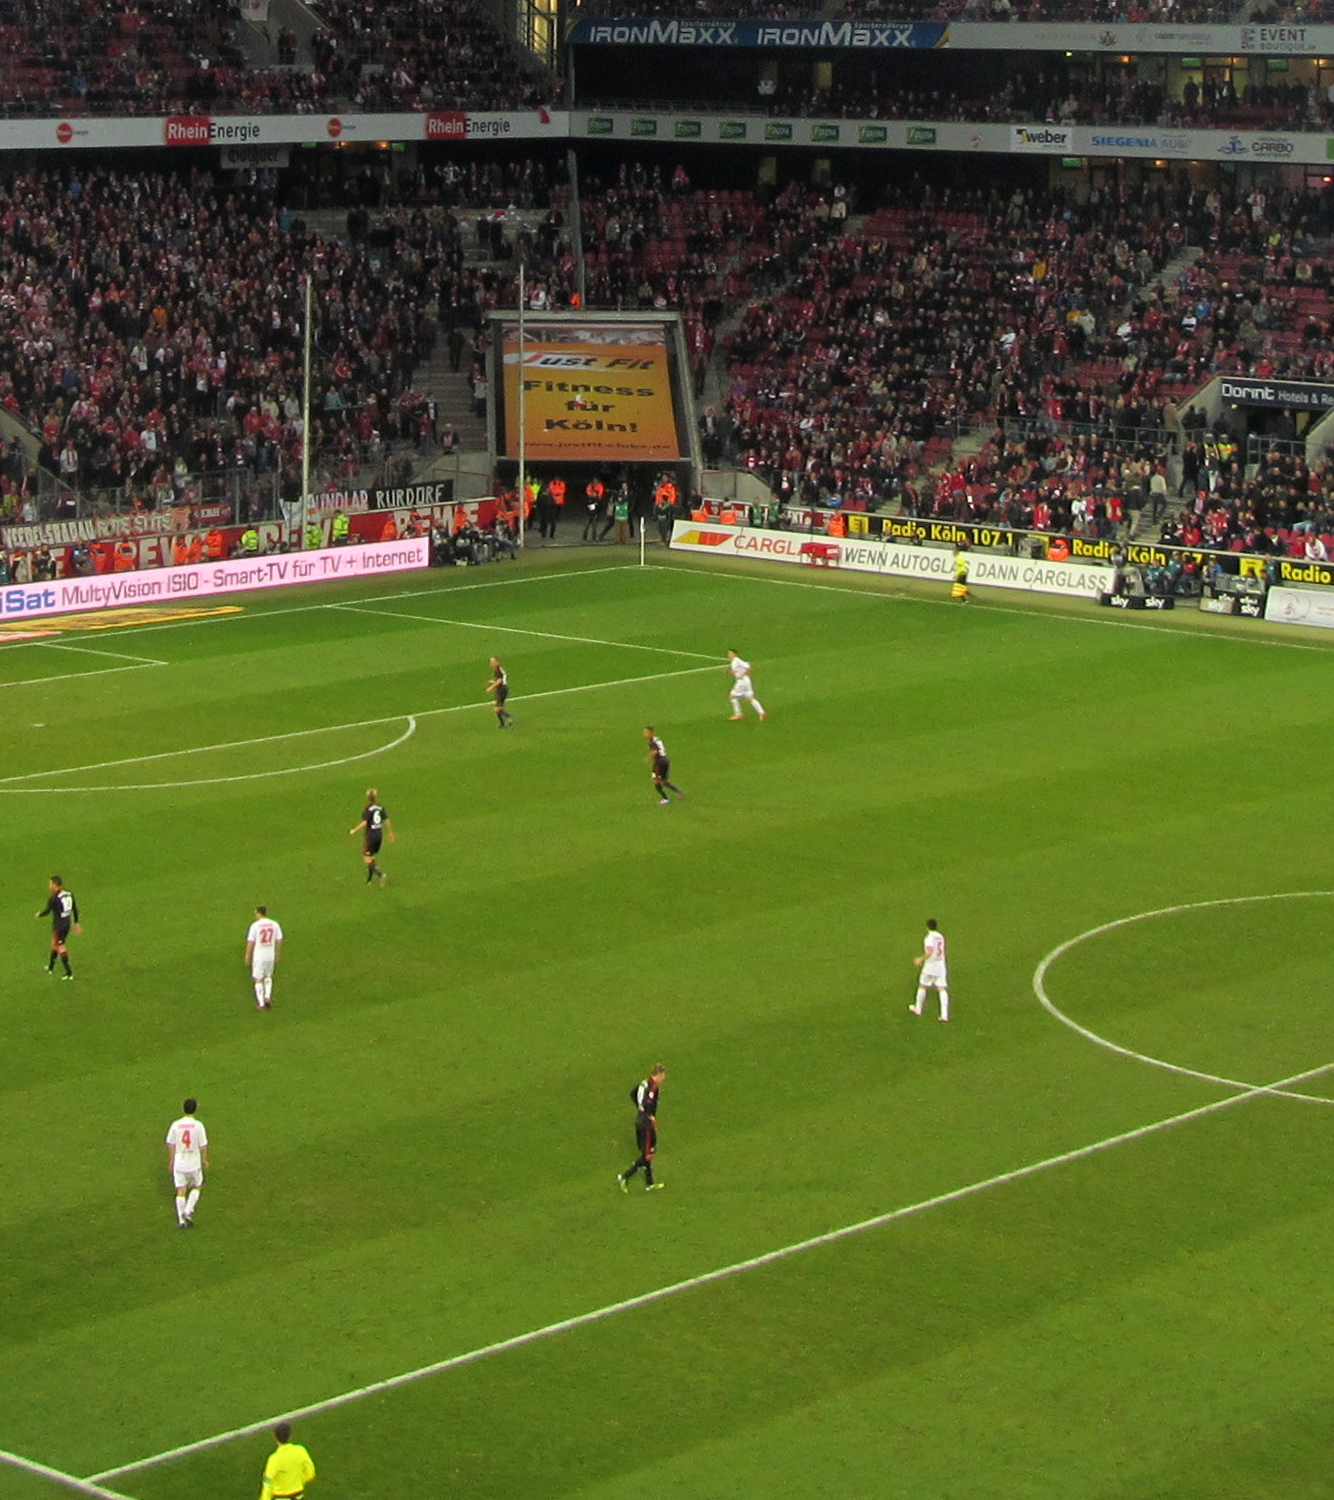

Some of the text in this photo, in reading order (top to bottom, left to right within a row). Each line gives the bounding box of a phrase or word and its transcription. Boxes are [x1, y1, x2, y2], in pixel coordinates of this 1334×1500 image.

[1260, 28, 1307, 42] EVENT
[167, 119, 261, 143] RheinEnergie
[428, 117, 511, 137] RheinEnergie
[1026, 128, 1067, 145] weber
[1091, 136, 1158, 148] SIEGENIA
[605, 357, 655, 370] Fit
[523, 379, 655, 397] Fitness
[1221, 383, 1275, 401] Dorint
[1277, 390, 1311, 404] Hotels
[1312, 393, 1321, 405] &
[564, 400, 616, 412] für
[545, 418, 638, 432] Köln!
[882, 518, 927, 540] Radio
[930, 524, 968, 545] Köln
[844, 547, 888, 568] WENN
[975, 562, 1019, 584] DANN
[1128, 547, 1168, 568] Köln
[62, 578, 160, 608] MultyVision
[213, 560, 288, 589] Smart-TV
[292, 557, 316, 578] für
[319, 555, 341, 574] TV
[361, 546, 423, 568] Internet
[1280, 561, 1332, 585] Radio
[1110, 595, 1166, 610] sky sky
[259, 927, 275, 945] 27
[181, 1129, 193, 1148] 4
